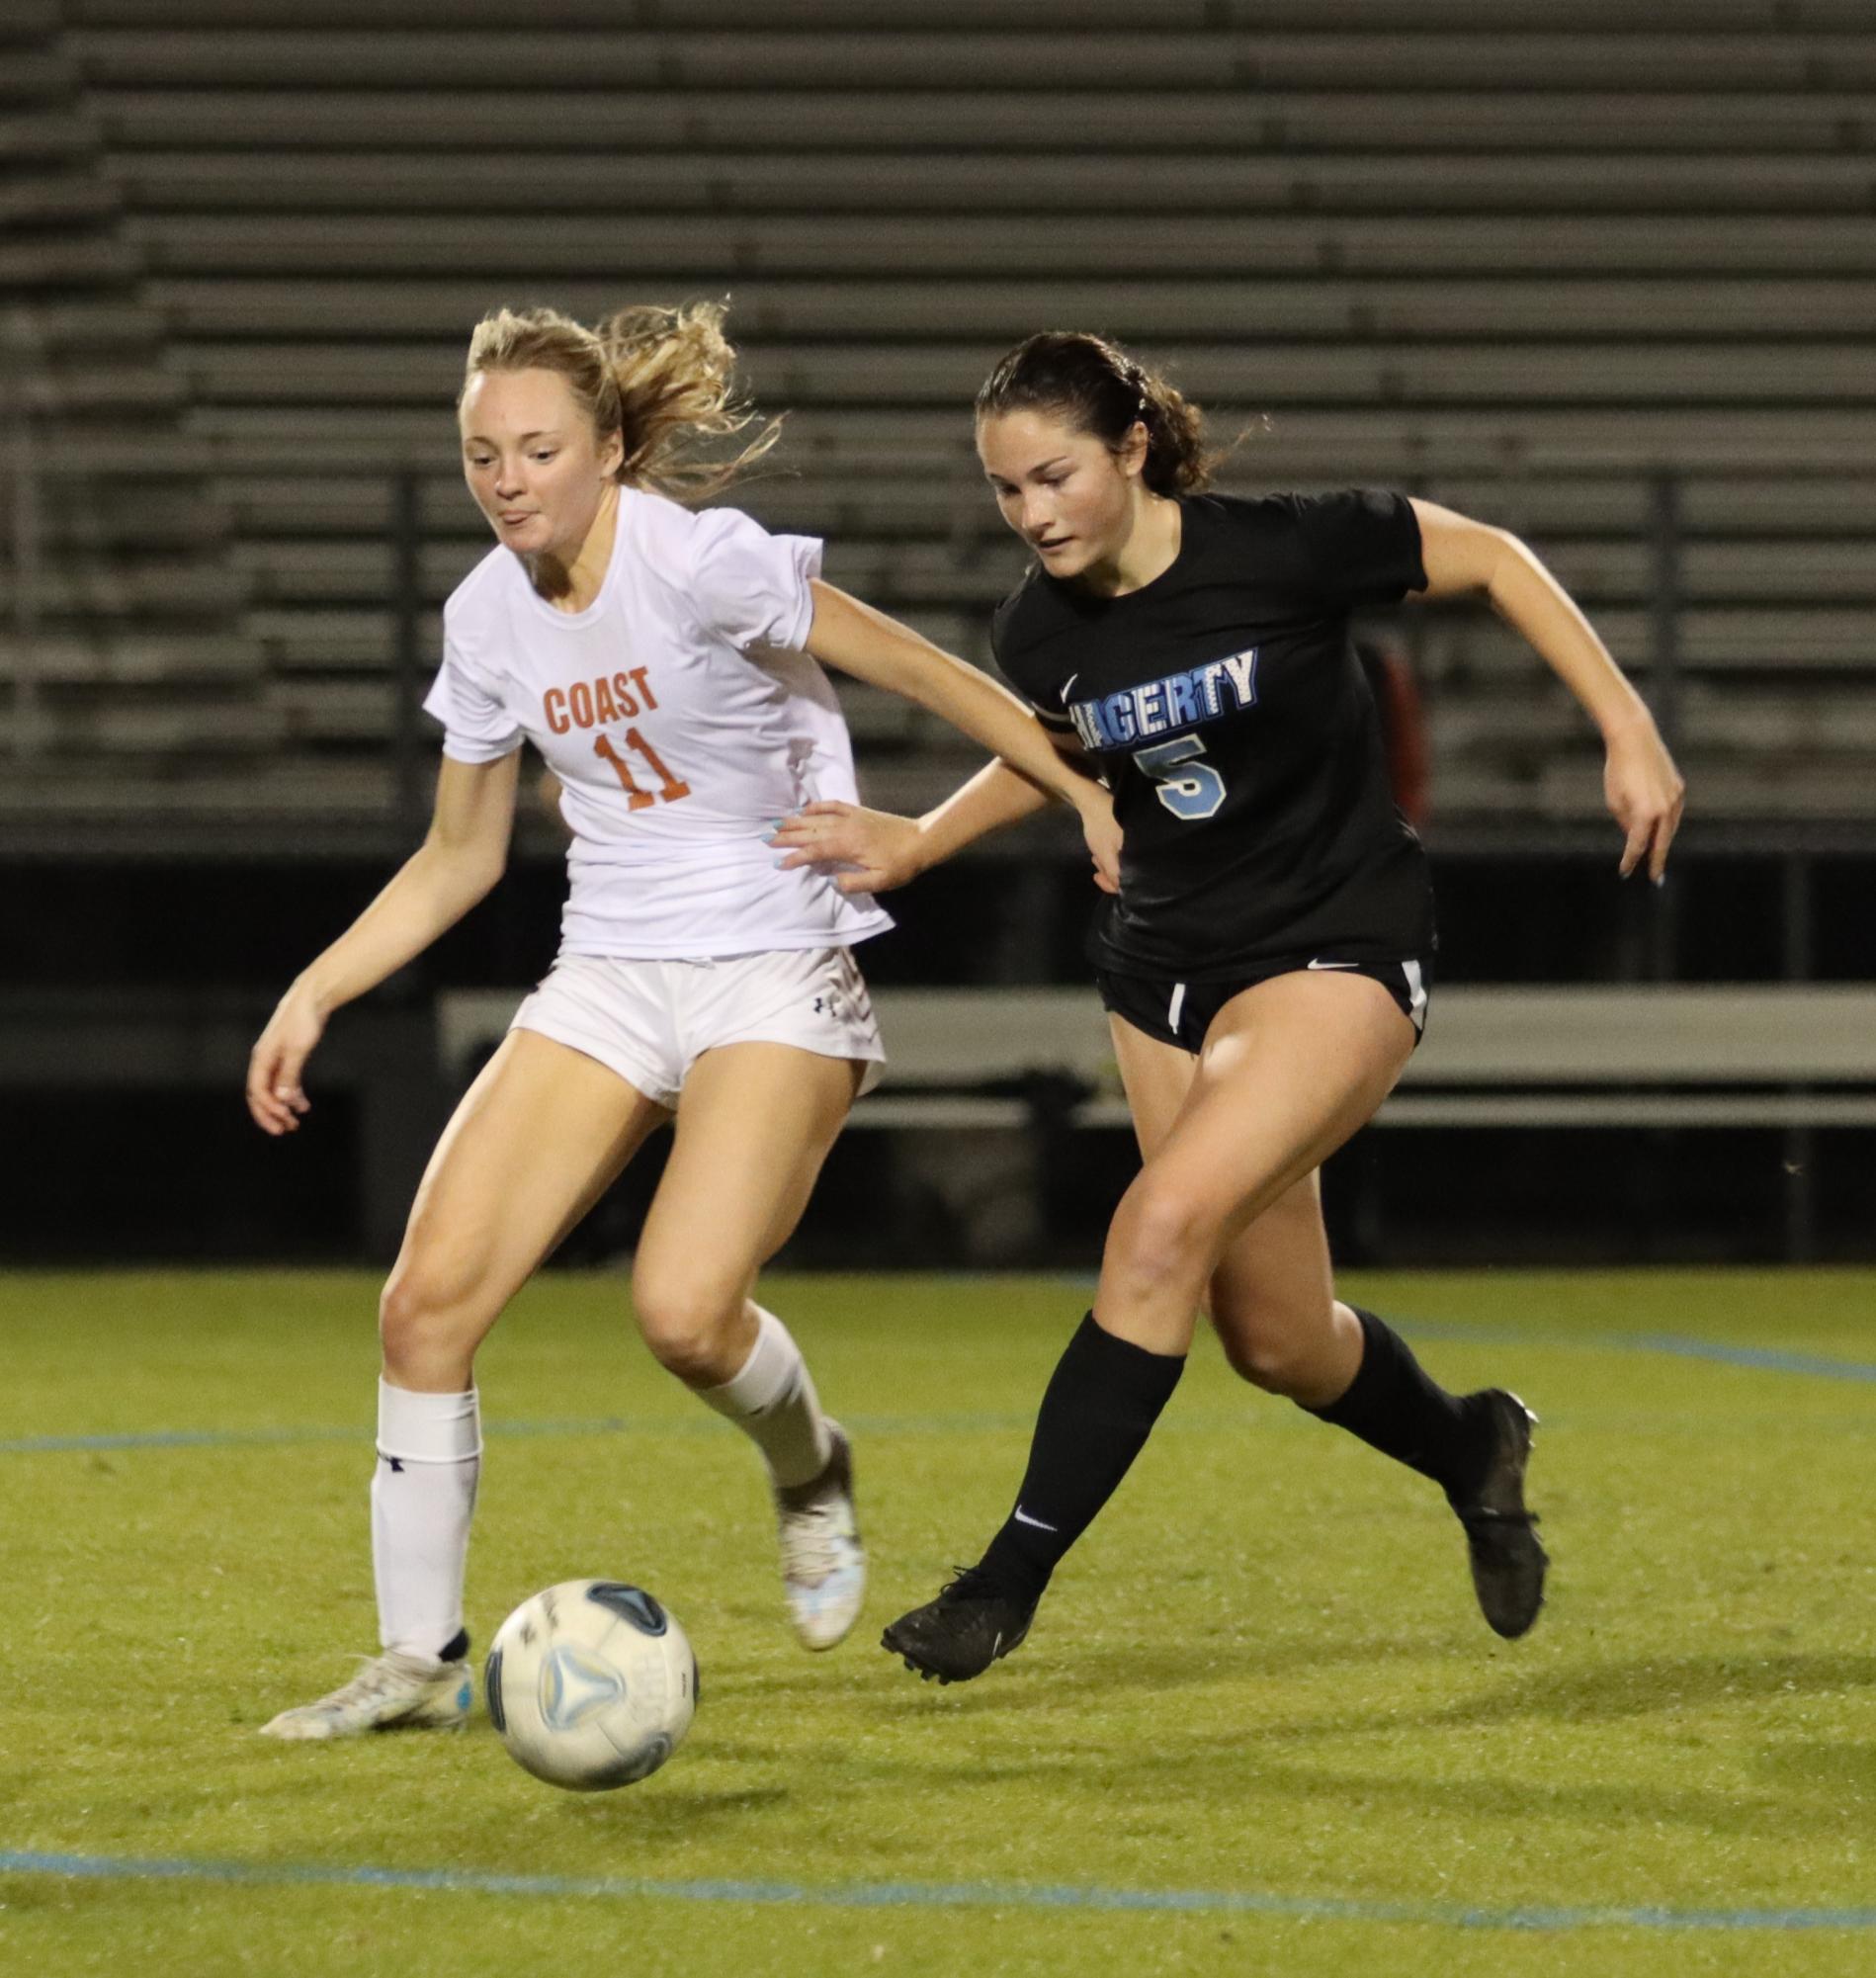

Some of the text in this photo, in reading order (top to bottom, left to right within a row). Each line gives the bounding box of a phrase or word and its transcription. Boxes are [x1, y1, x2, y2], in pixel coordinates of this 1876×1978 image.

[544, 666, 658, 734] COAST
[594, 727, 691, 812] 11
[1132, 732, 1227, 820] 5
